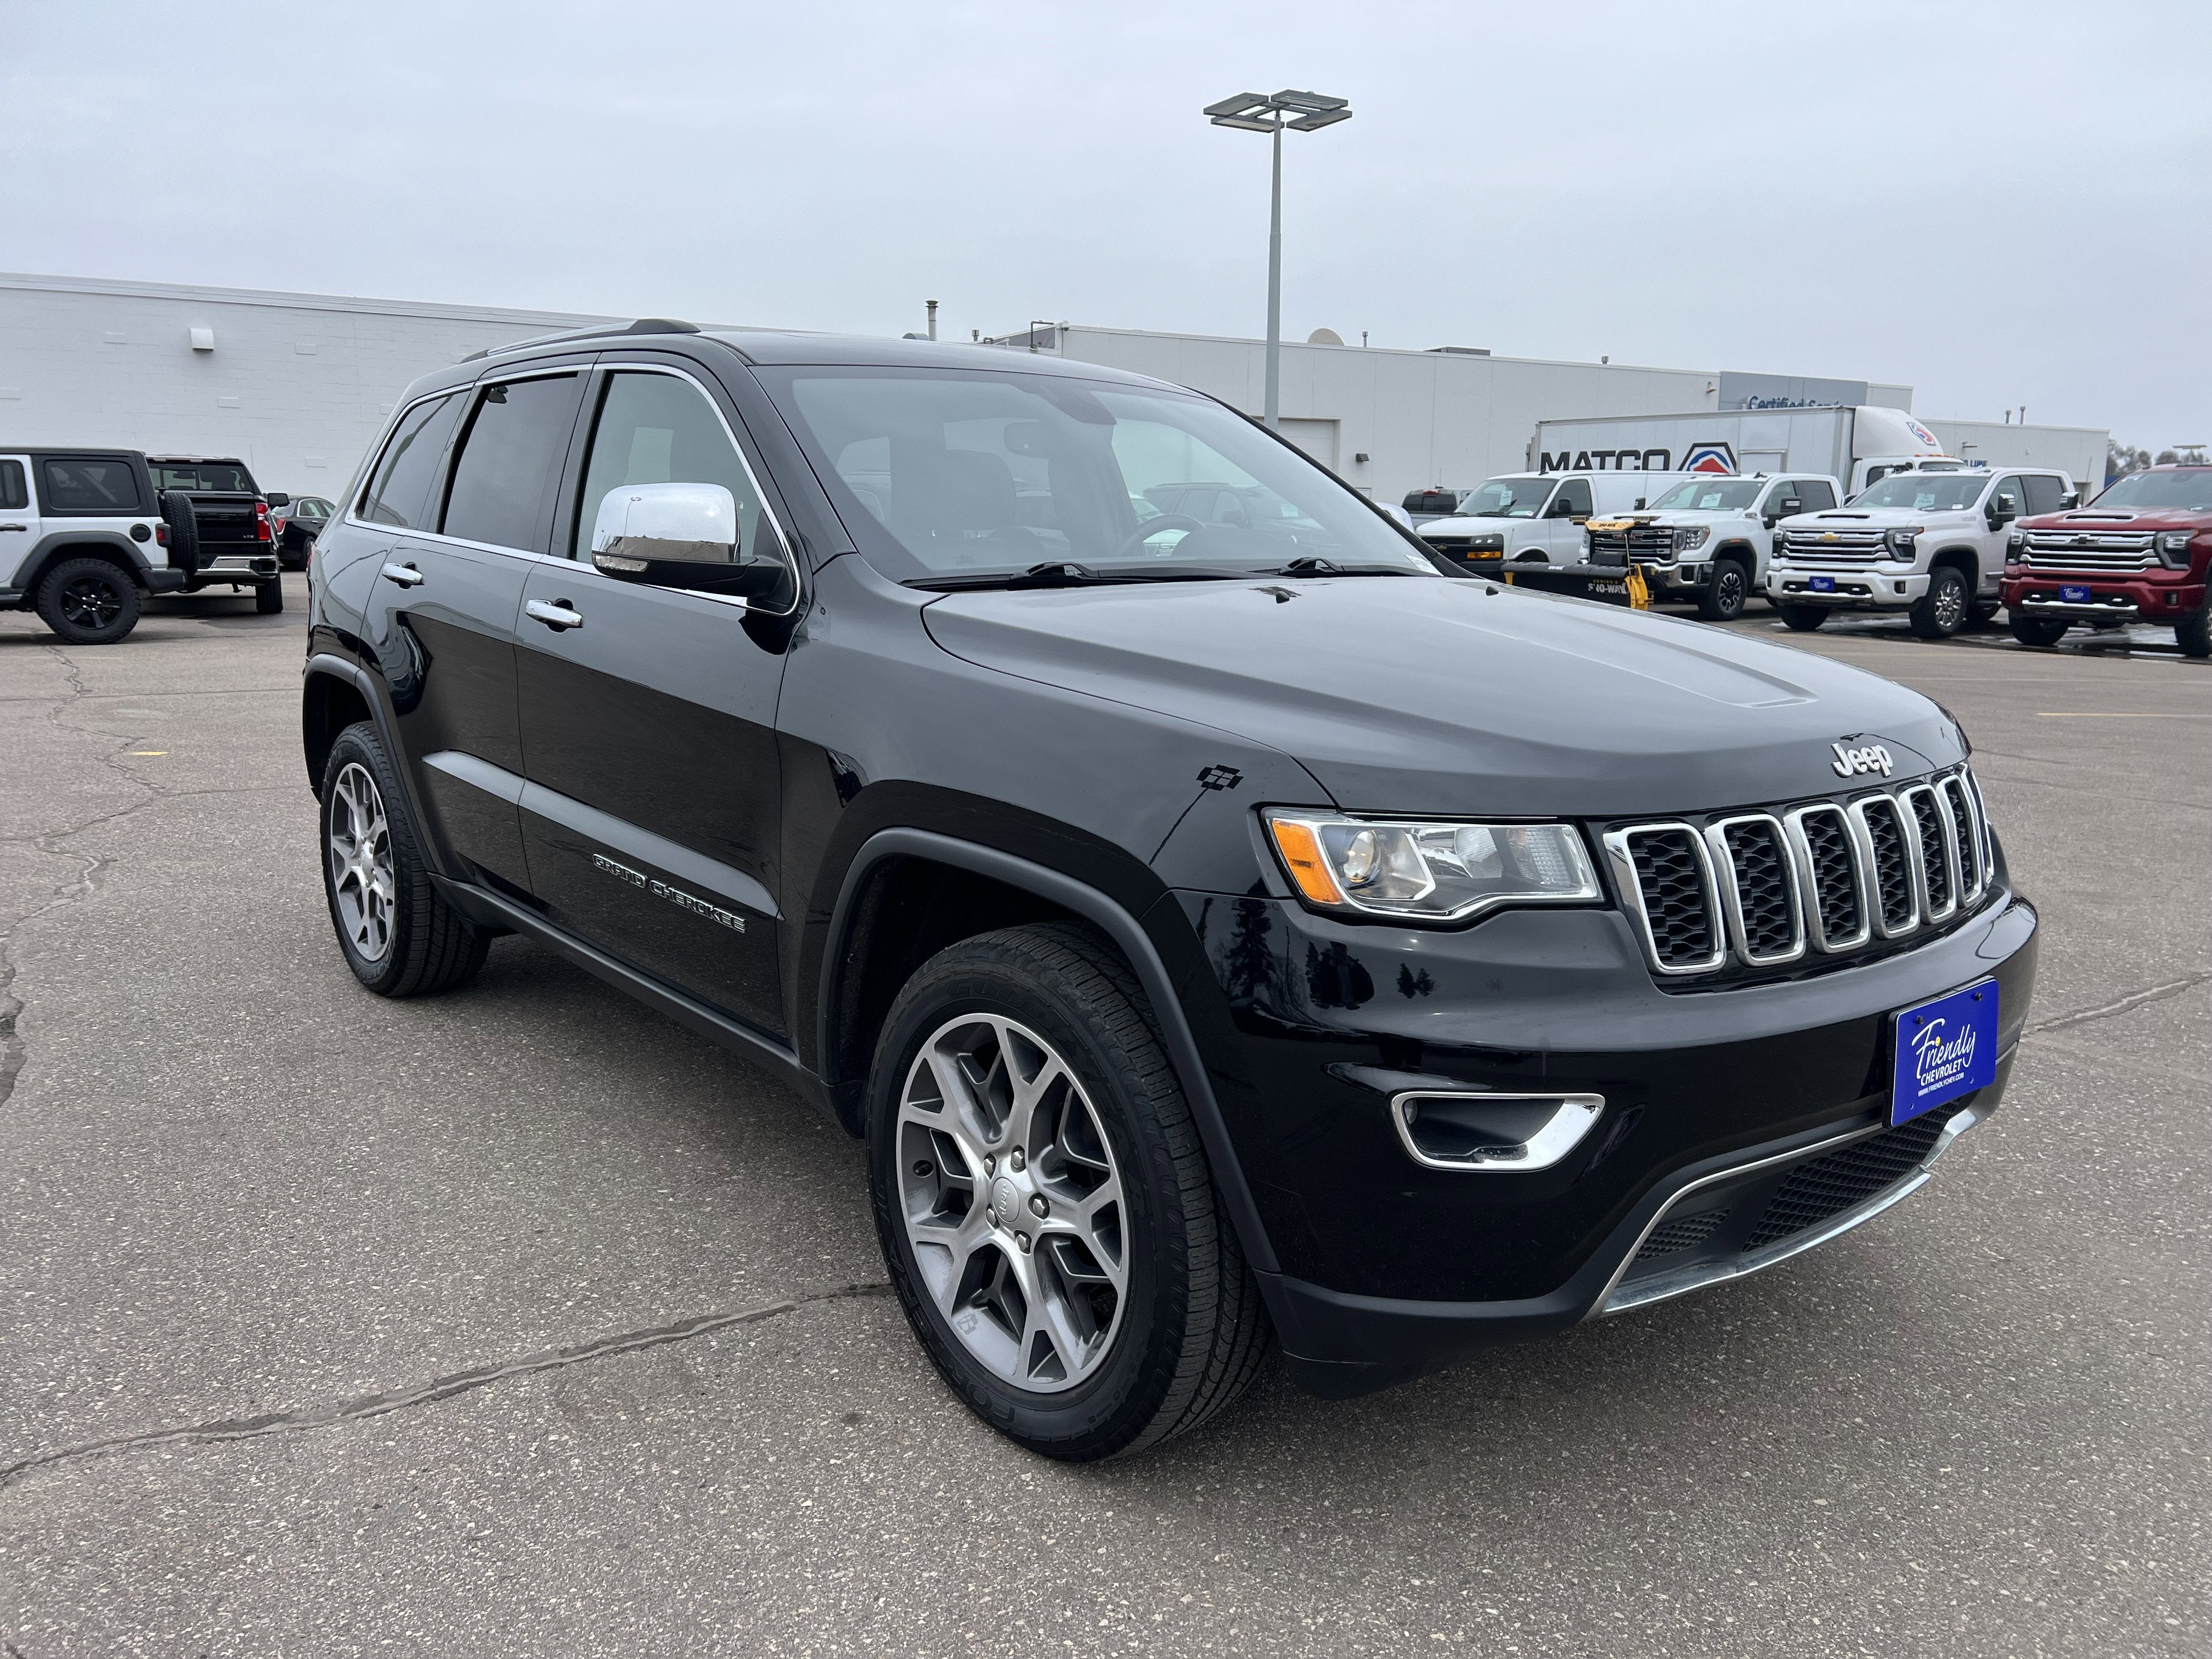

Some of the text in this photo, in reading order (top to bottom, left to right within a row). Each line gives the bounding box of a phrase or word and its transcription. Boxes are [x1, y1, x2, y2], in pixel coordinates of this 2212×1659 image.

[1541, 449, 1671, 471] MATCO
[1831, 743, 1893, 778] Jeep
[592, 854, 746, 933] GRAND CHEROKEE
[1911, 1018, 1976, 1080] Friendly
[1917, 1071, 1965, 1097] WWW.FRIENDLYCHEV.COM
[1921, 1058, 1962, 1087] CHEVROLET
[998, 1183, 1010, 1216] Jeep
